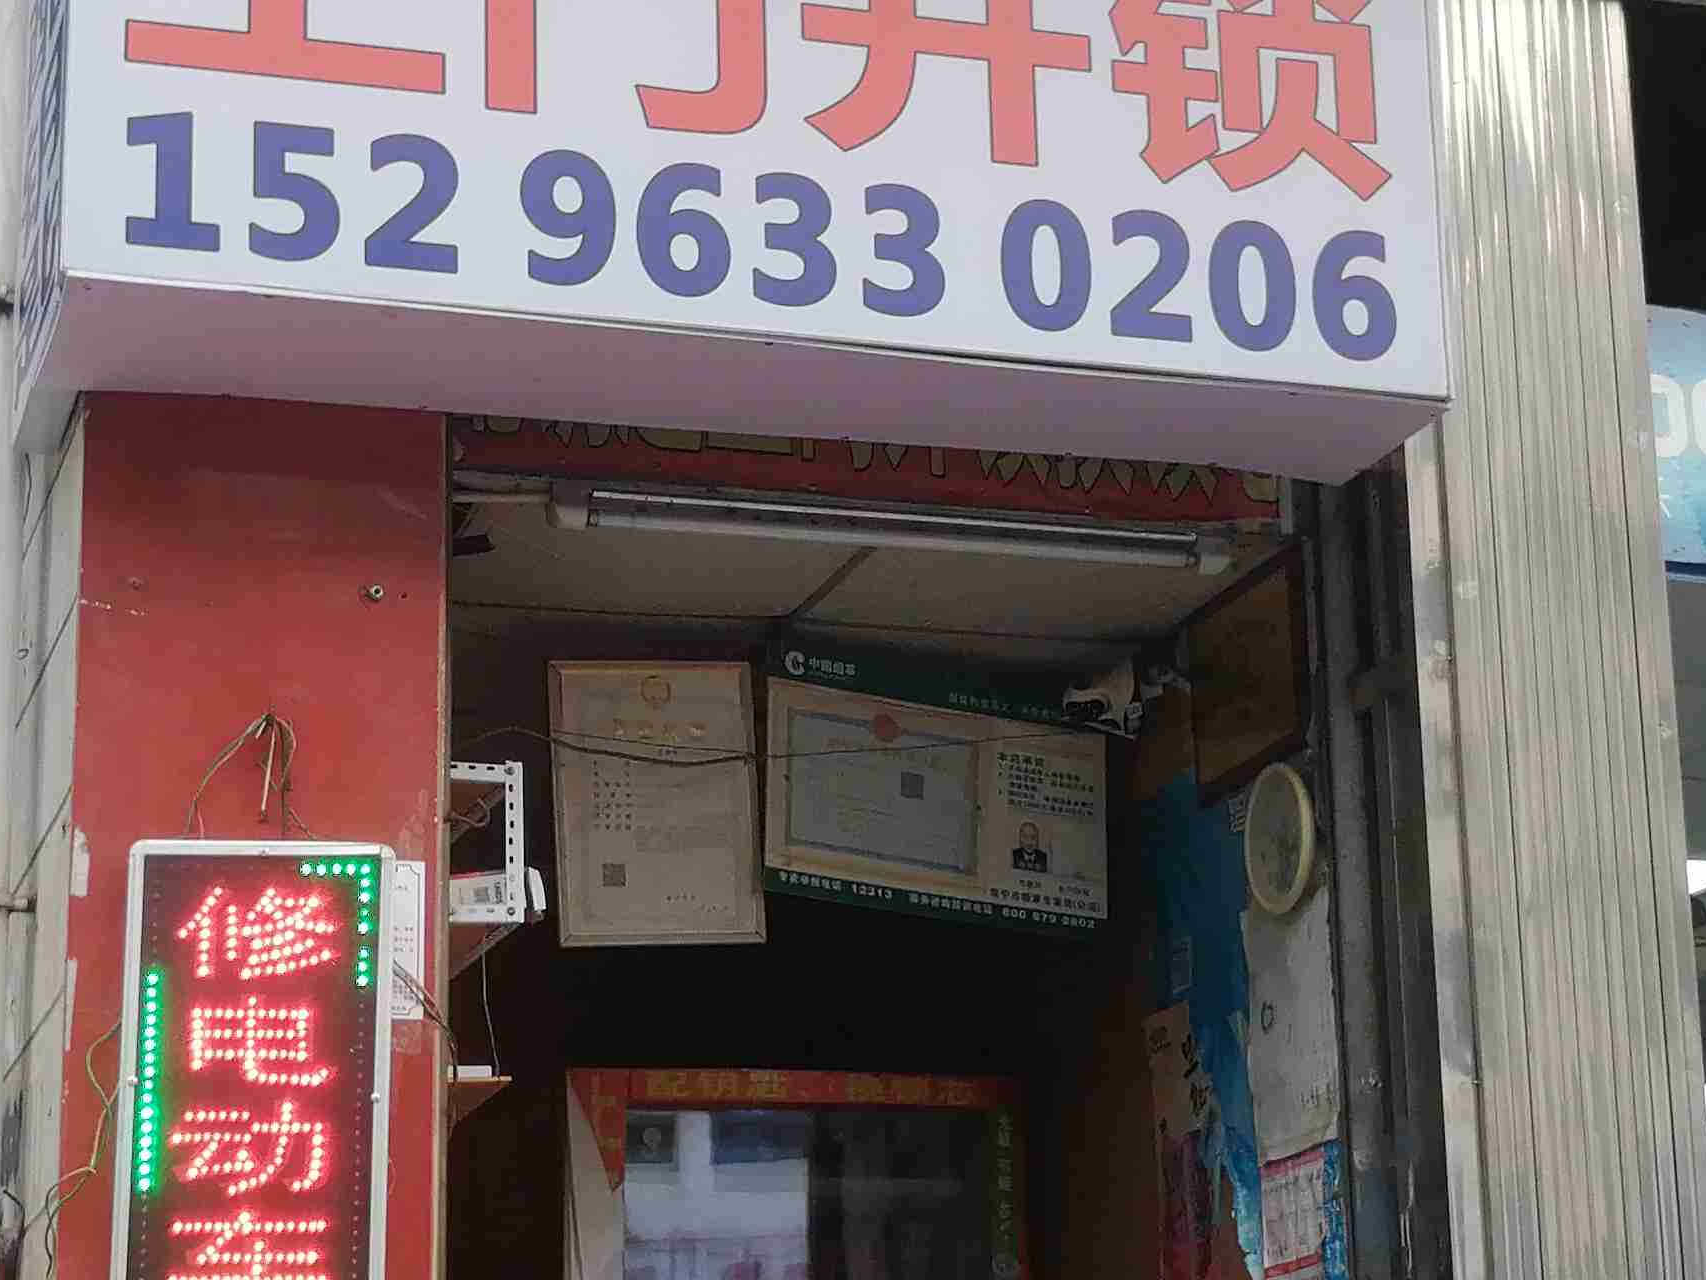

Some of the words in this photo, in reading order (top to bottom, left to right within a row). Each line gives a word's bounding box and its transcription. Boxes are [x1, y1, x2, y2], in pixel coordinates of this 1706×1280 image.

[126, 111, 462, 274] 152
[518, 148, 950, 317] 9633
[999, 198, 1398, 362] 0206
